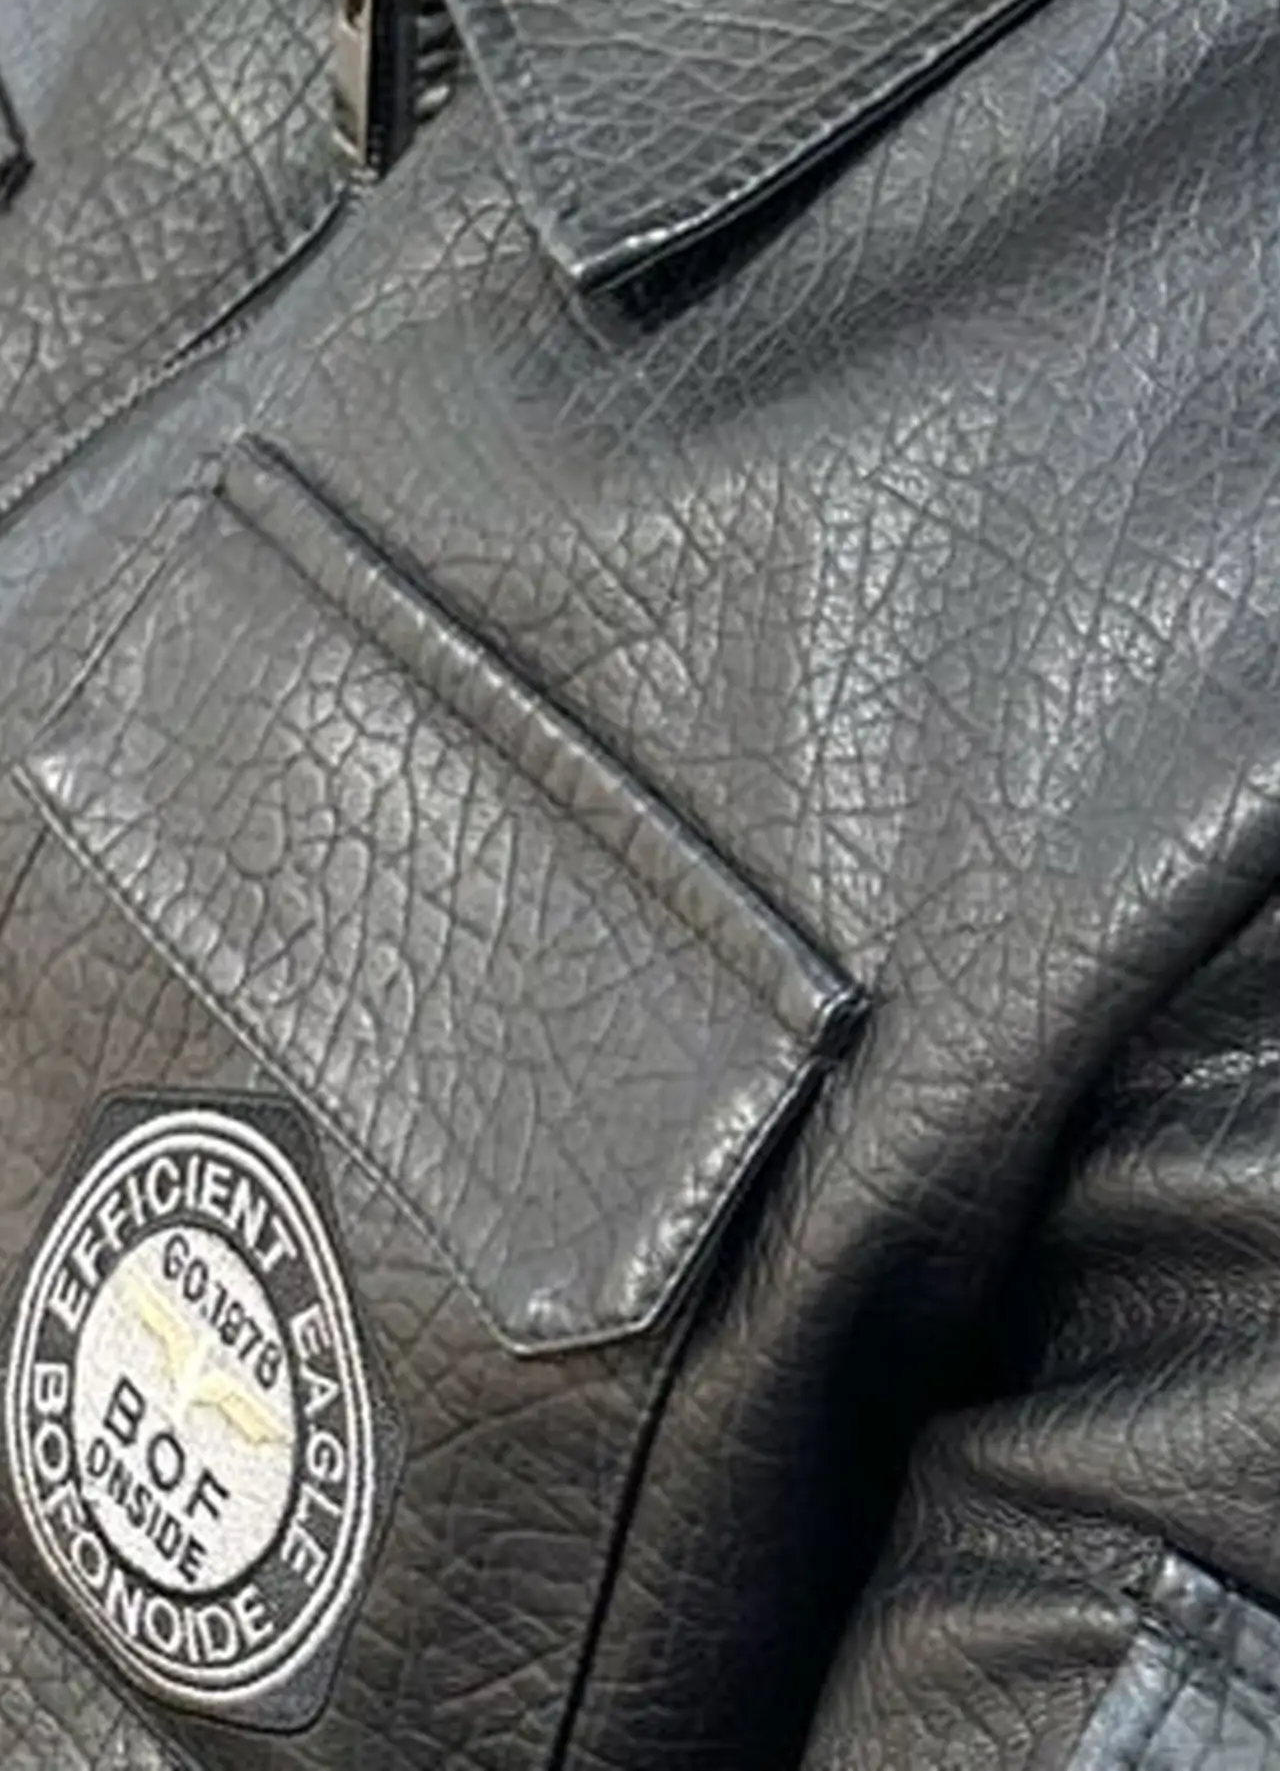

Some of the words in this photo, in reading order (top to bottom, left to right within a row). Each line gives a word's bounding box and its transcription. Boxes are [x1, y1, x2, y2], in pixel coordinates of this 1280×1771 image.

[48, 1154, 299, 1332] EFFICIENT
[281, 1303, 345, 1588] EAGLE
[85, 1437, 208, 1585] ONSIDE
[102, 1373, 230, 1520] BOF
